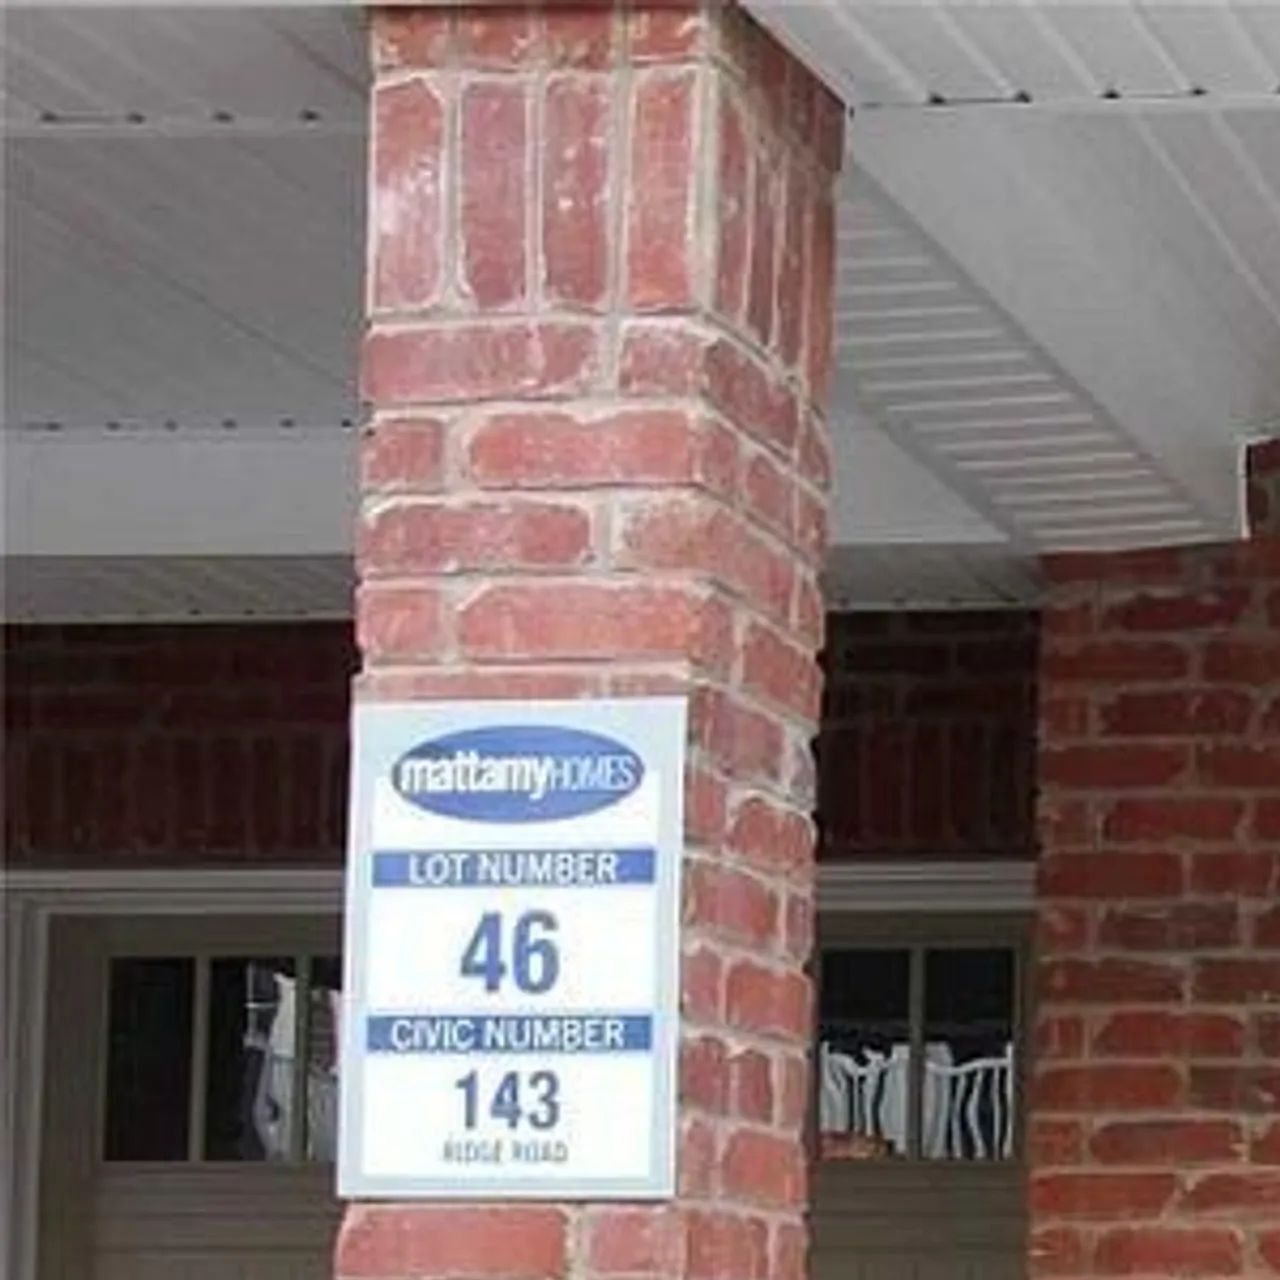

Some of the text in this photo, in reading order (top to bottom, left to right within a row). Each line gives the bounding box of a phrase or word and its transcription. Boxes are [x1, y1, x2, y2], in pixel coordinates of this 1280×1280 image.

[409, 852, 621, 885] LOT NUMBER
[459, 908, 561, 996] 46
[390, 1017, 626, 1050] CIVIC NUMBER
[454, 1068, 562, 1131] 143
[512, 1139, 569, 1164] ROAD
